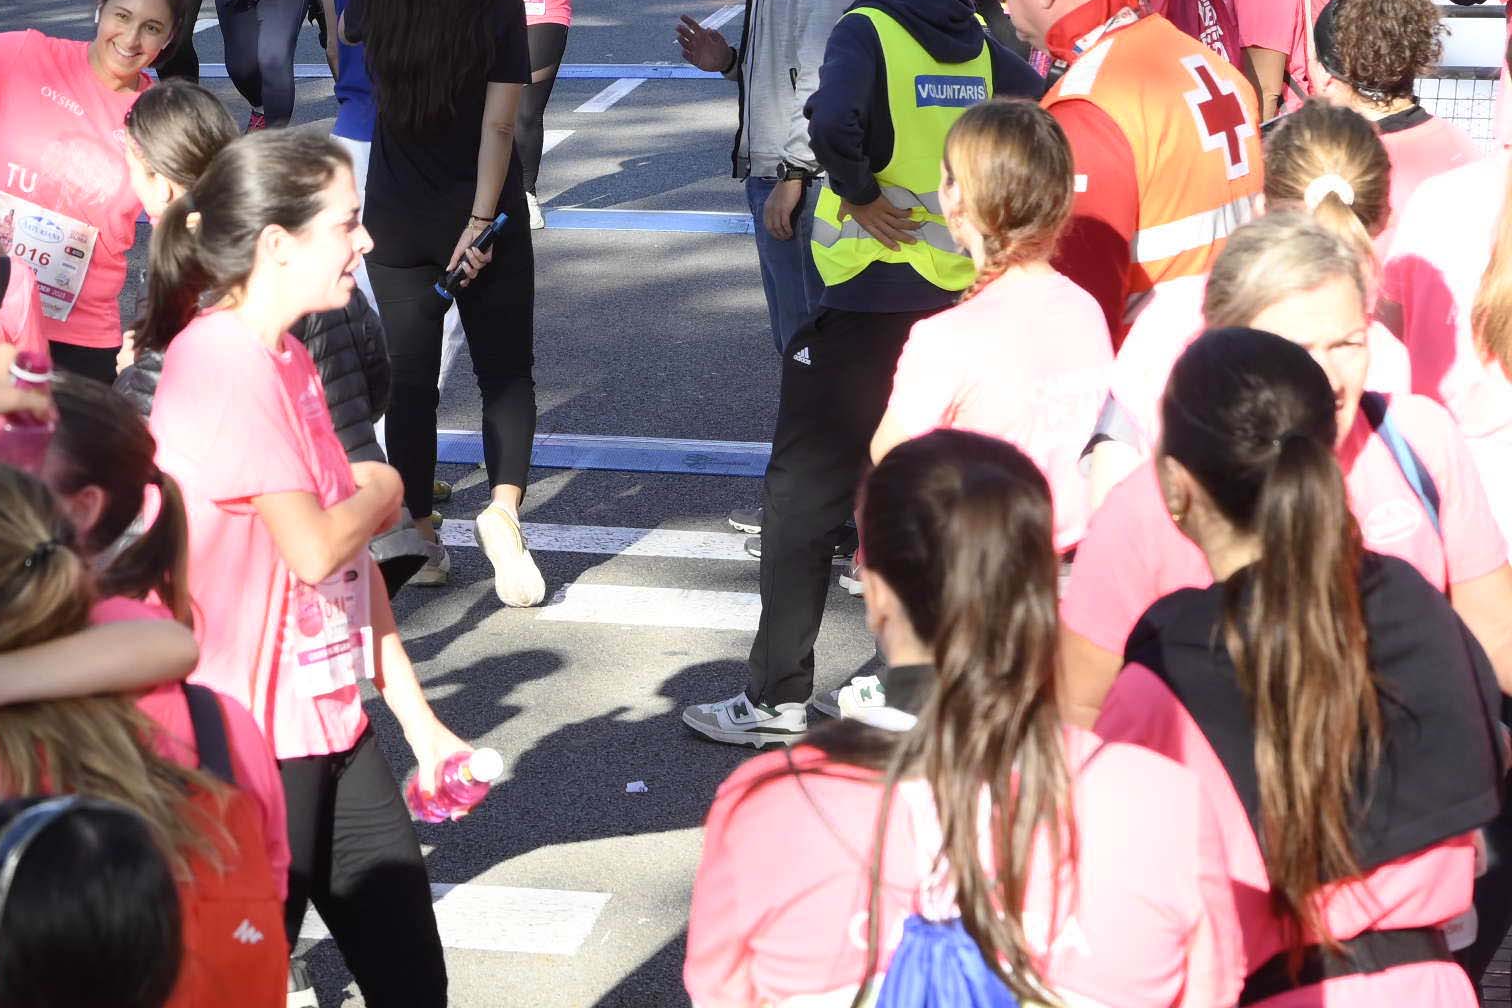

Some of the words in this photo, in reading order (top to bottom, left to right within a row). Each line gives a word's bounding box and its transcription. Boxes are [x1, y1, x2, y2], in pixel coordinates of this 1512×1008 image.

[41, 86, 84, 117] OYSHO
[917, 84, 986, 101] VOLUNTARIS
[7, 162, 38, 193] TU
[14, 242, 51, 267] 016
